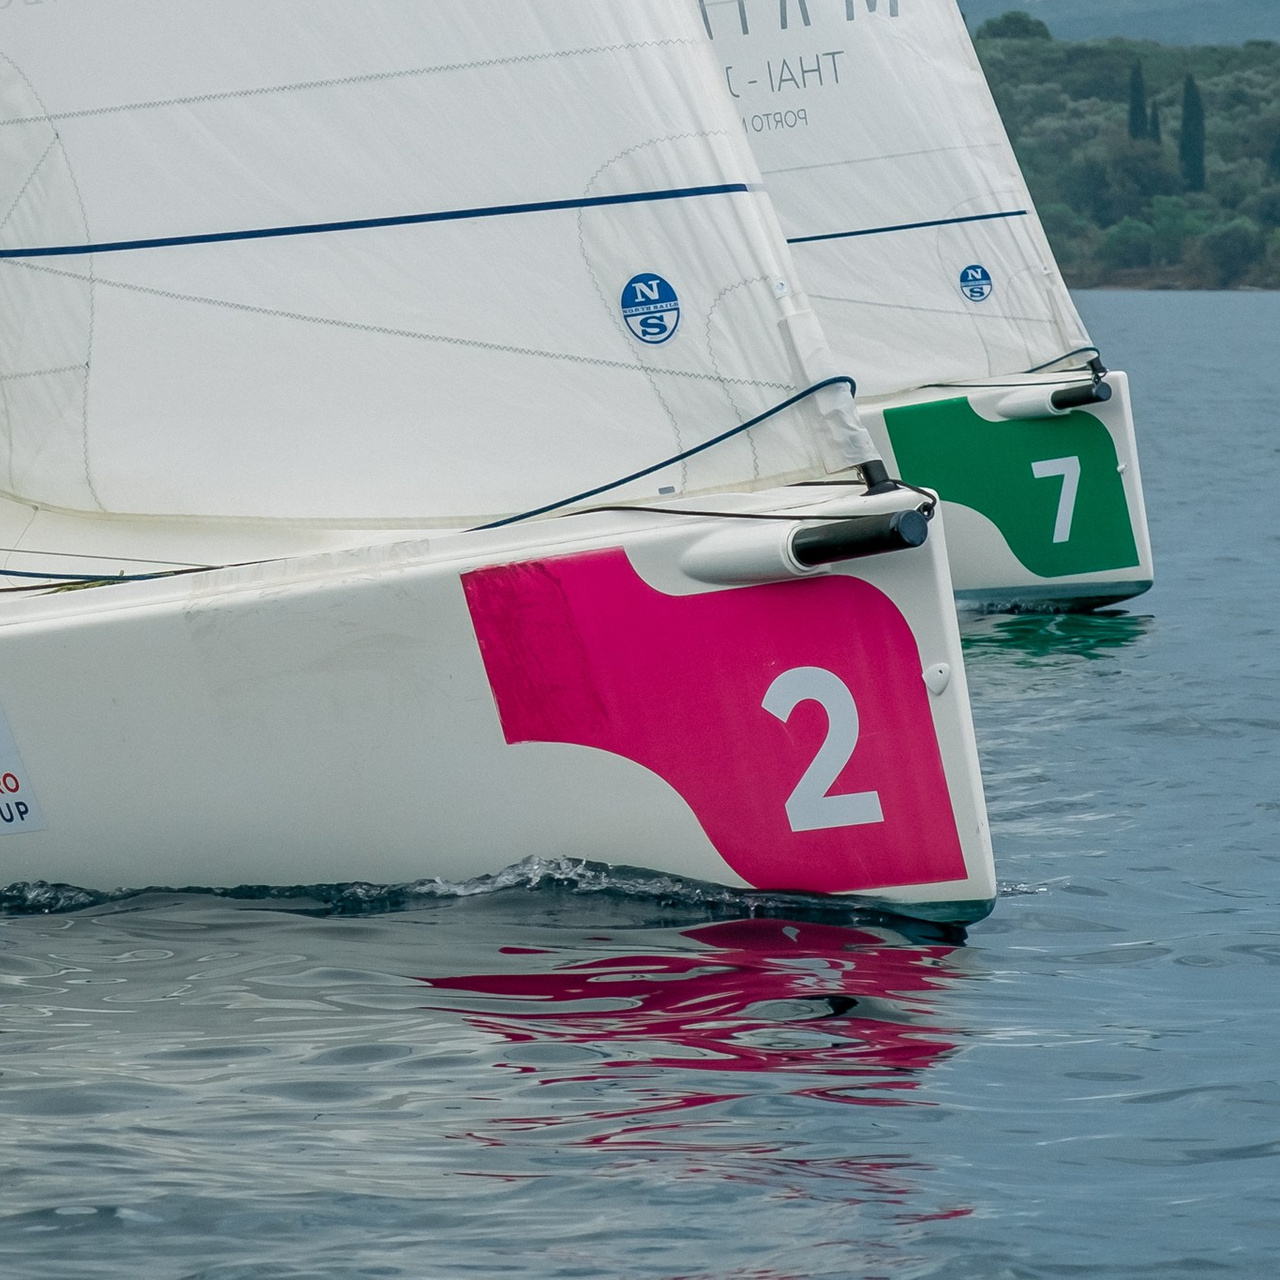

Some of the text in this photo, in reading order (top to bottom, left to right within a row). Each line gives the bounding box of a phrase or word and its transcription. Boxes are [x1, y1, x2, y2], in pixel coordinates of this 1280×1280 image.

[966, 268, 983, 281] N
[631, 279, 660, 303] N
[969, 286, 985, 298] S
[639, 314, 668, 337] S
[1031, 455, 1081, 543] 7
[761, 666, 885, 833] 2
